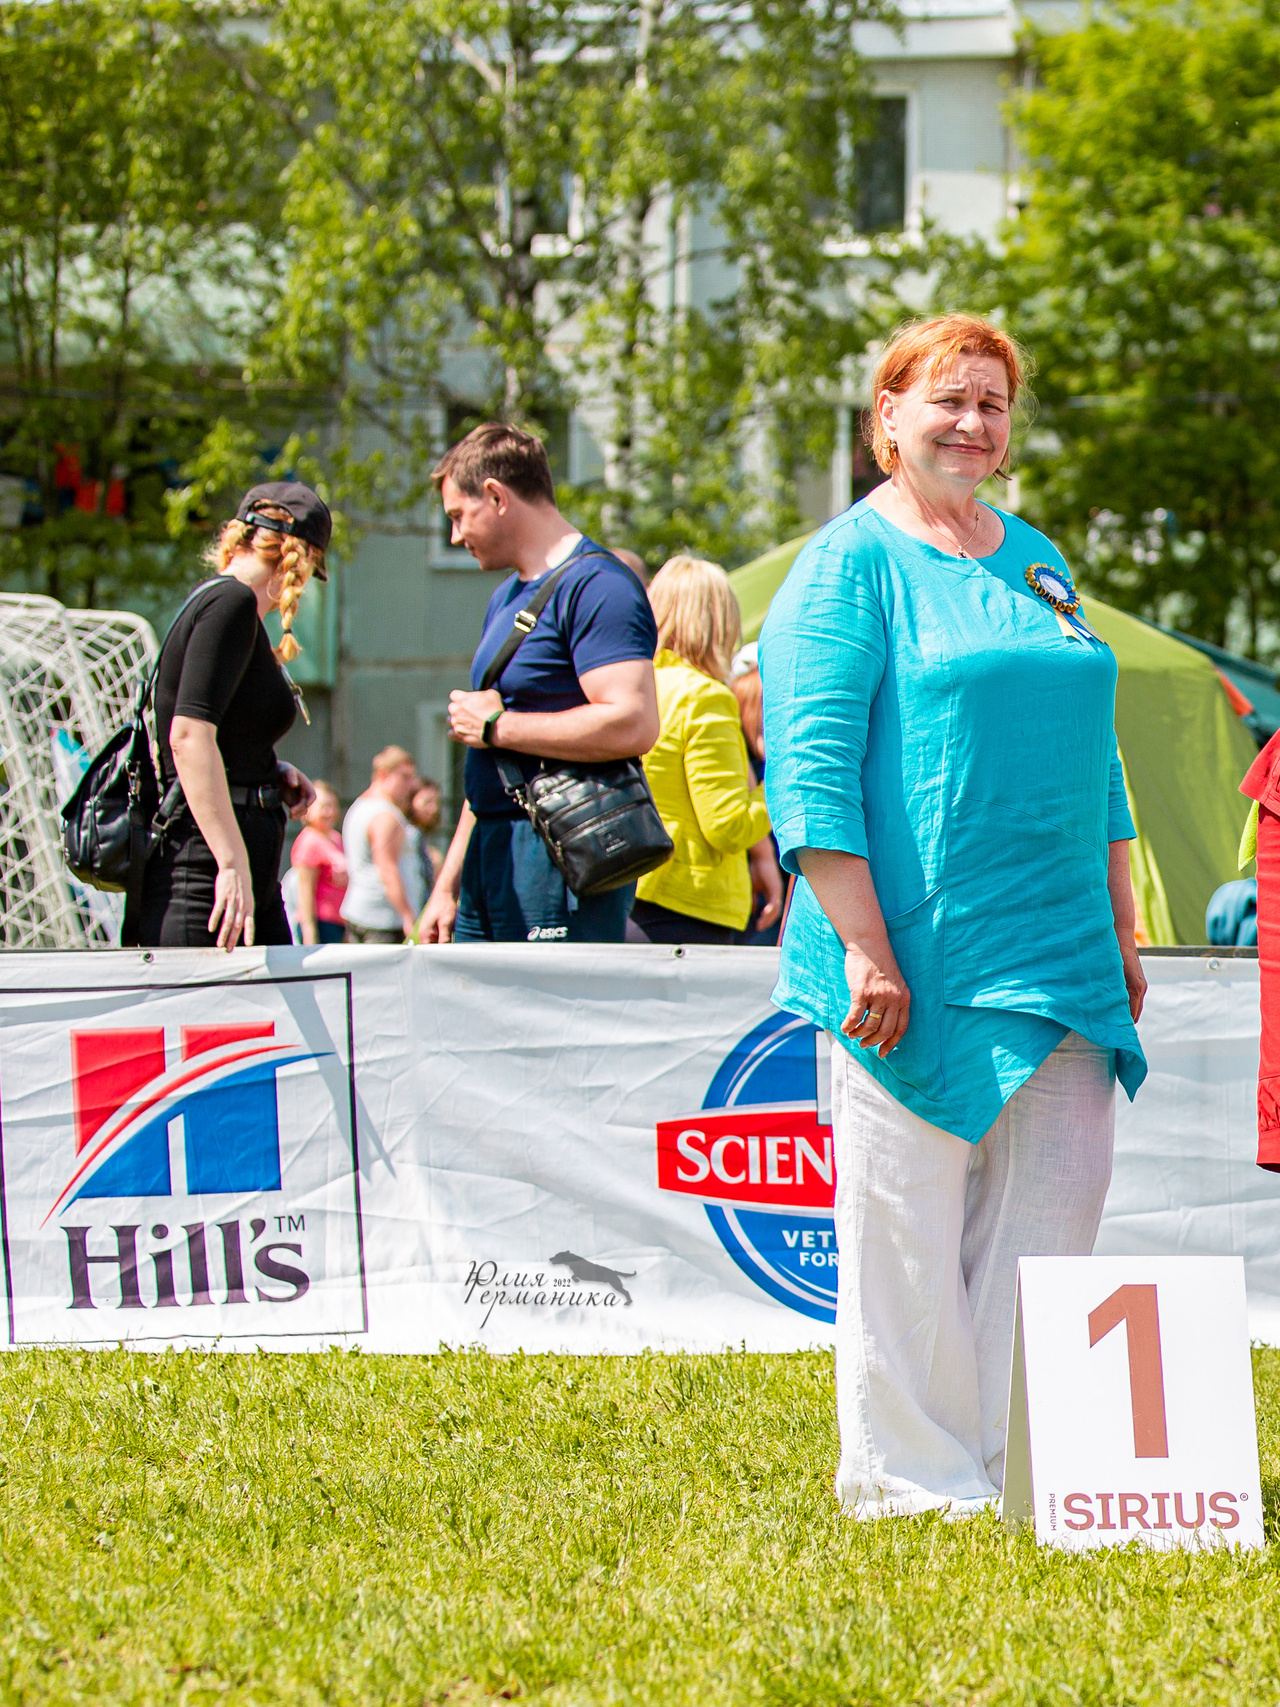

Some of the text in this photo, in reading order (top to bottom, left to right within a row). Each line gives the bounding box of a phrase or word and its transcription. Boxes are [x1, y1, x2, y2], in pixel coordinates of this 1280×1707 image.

[60, 1217, 310, 1309] Hill's
[782, 1229, 838, 1248] VET
[1088, 1284, 1169, 1459] 1
[1048, 1493, 1057, 1532] PREMIUM
